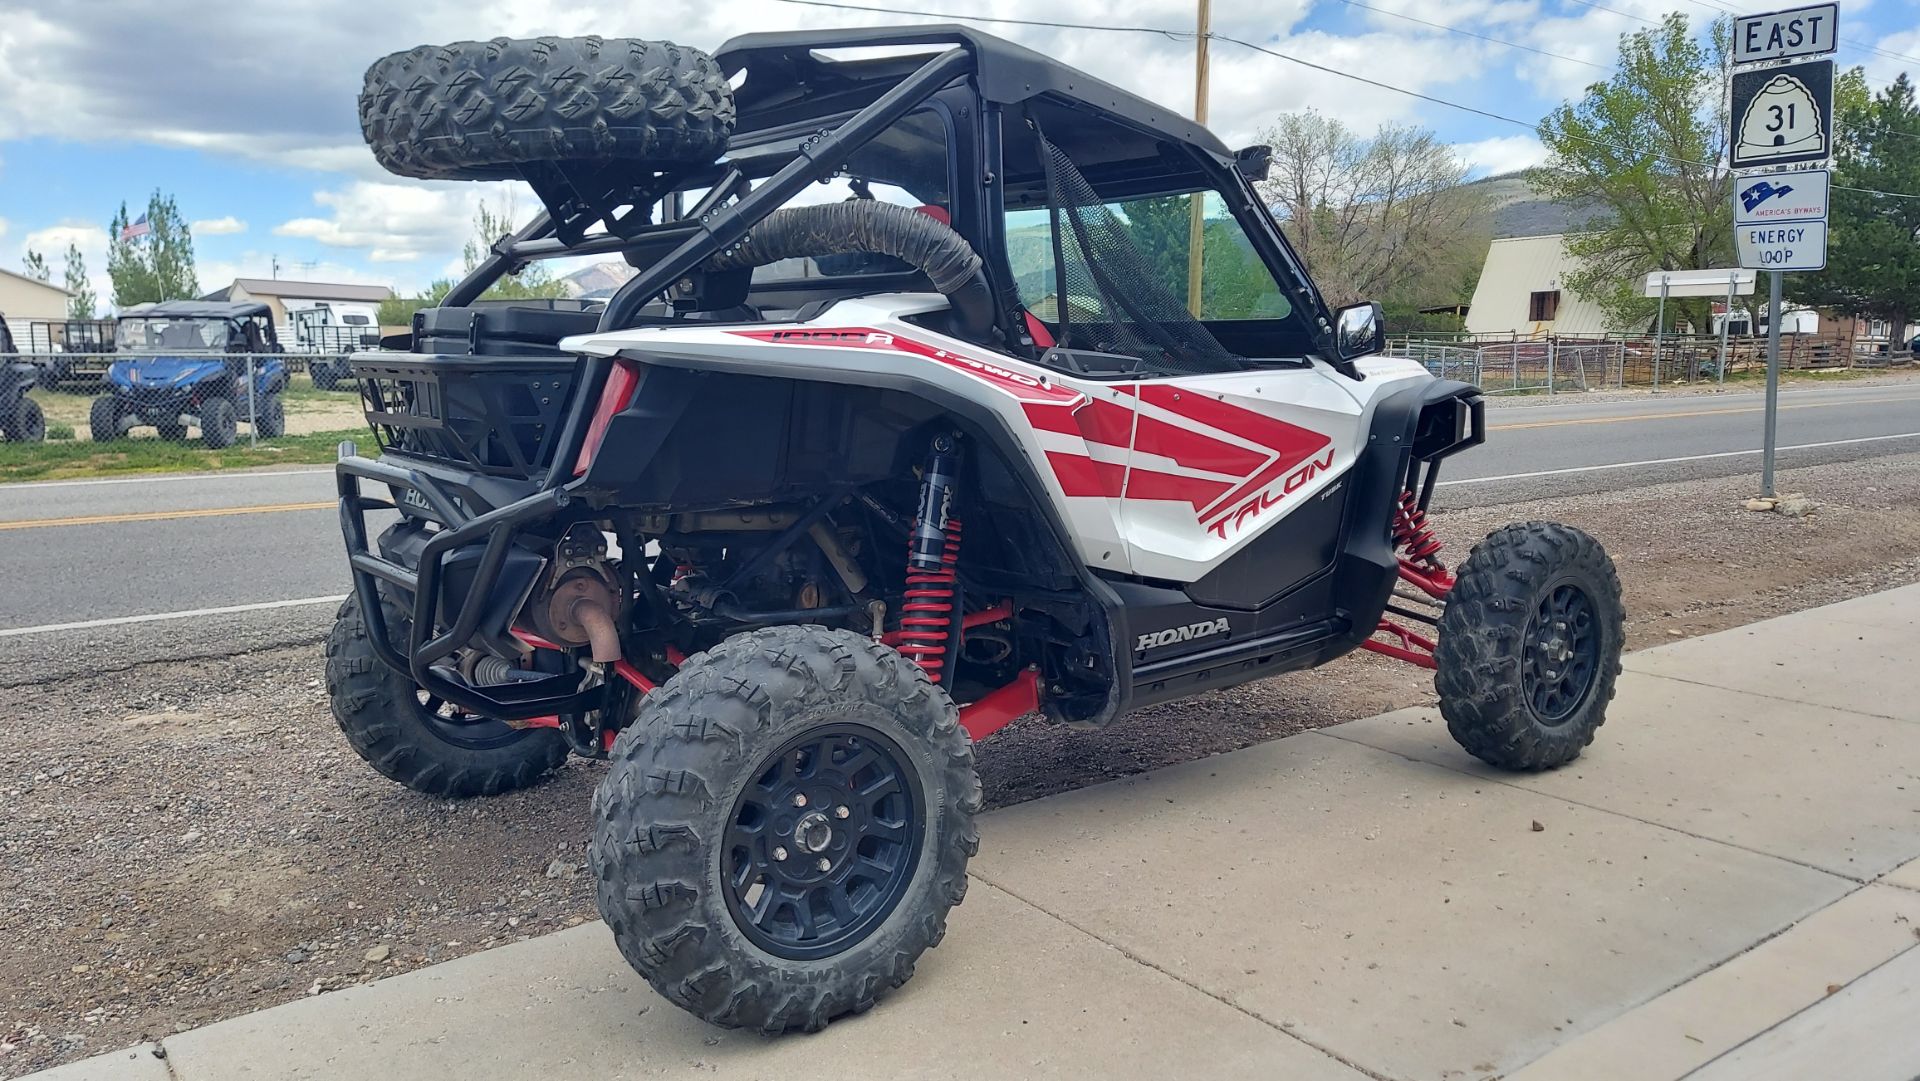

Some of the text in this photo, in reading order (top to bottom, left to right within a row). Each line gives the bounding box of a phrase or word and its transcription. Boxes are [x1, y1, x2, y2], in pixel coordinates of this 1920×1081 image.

[1746, 16, 1823, 53] EAST
[1765, 103, 1795, 132] 31
[1755, 206, 1821, 217] AMERICA'S BYWAYS
[1750, 228, 1805, 244] ENERGY
[1759, 250, 1793, 264] LOOP
[772, 331, 894, 345] 1000R
[1207, 448, 1335, 540] TALON
[1135, 617, 1230, 651] HONDA
